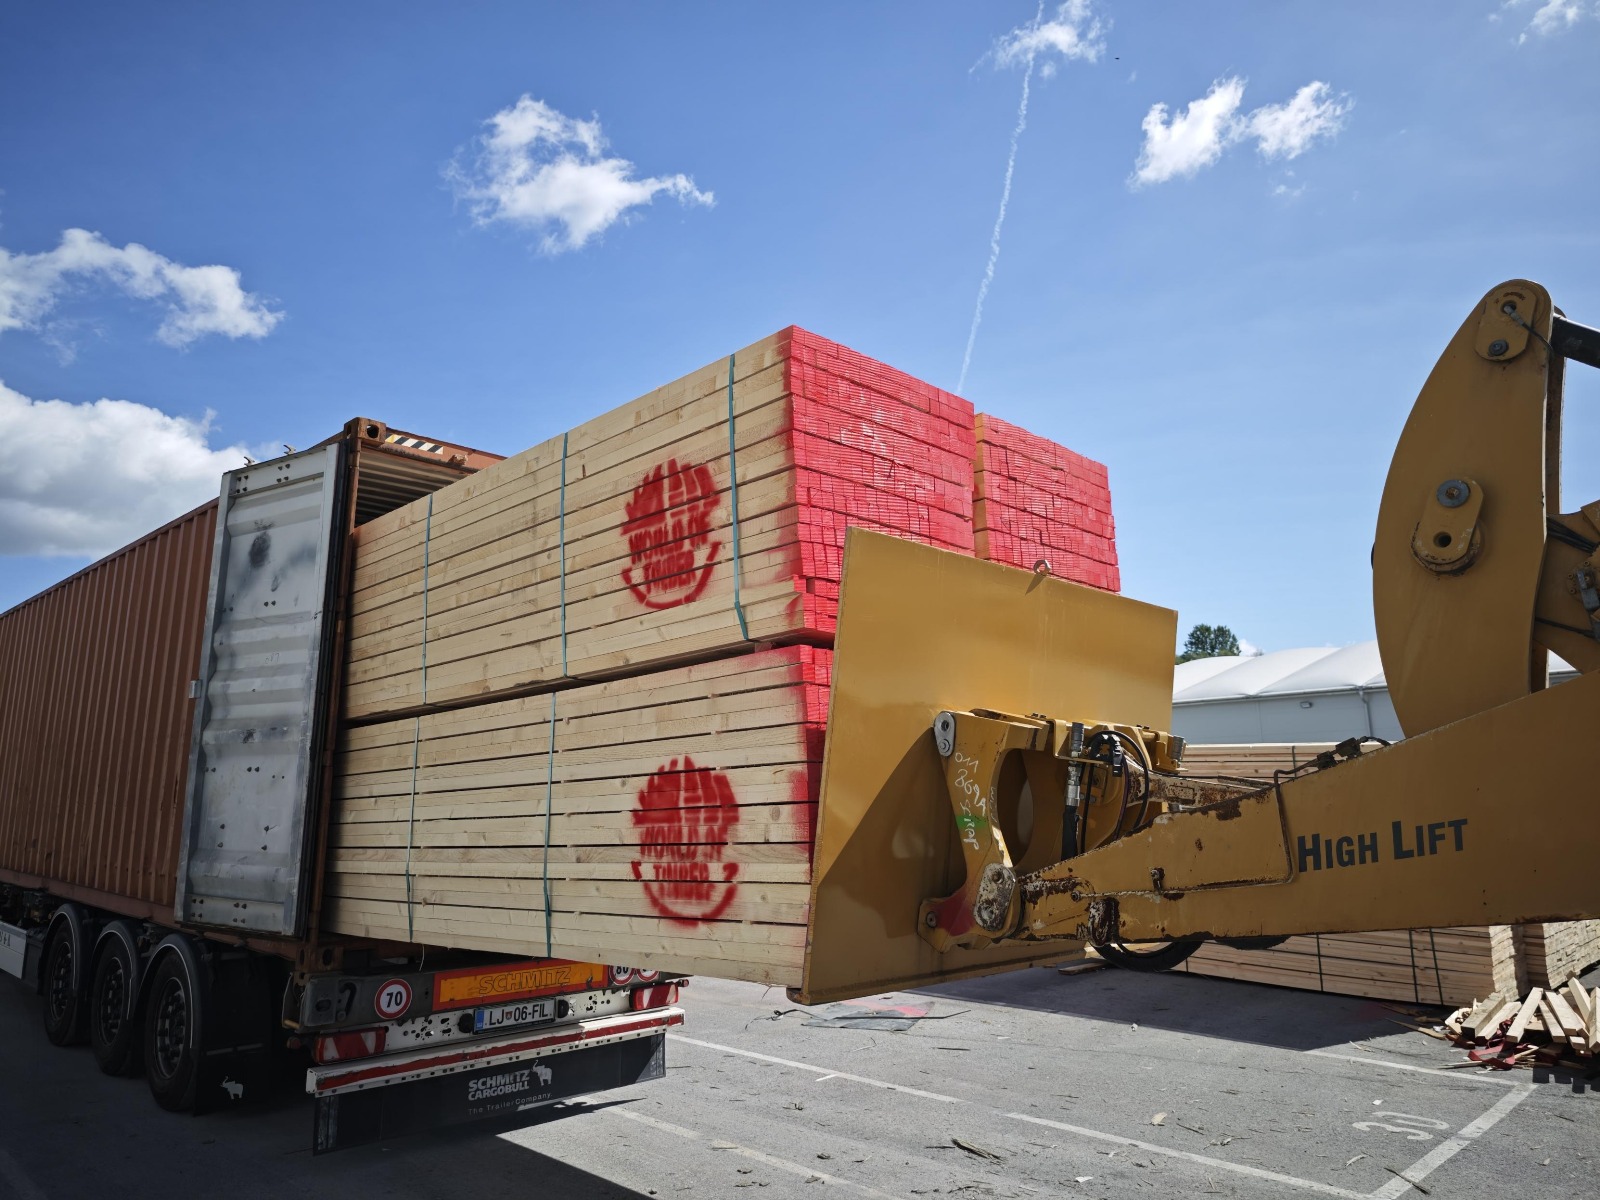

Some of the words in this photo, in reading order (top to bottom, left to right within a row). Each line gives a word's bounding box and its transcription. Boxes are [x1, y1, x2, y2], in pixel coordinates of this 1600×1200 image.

[1297, 833, 1379, 873] HIGH
[1391, 818, 1468, 860] LIFT
[479, 966, 572, 995] SCHMITZ
[386, 991, 403, 1009] 70
[467, 1080, 530, 1102] CARGOBULL
[468, 1068, 531, 1093] SCHMITZ
[468, 1106, 485, 1117] The
